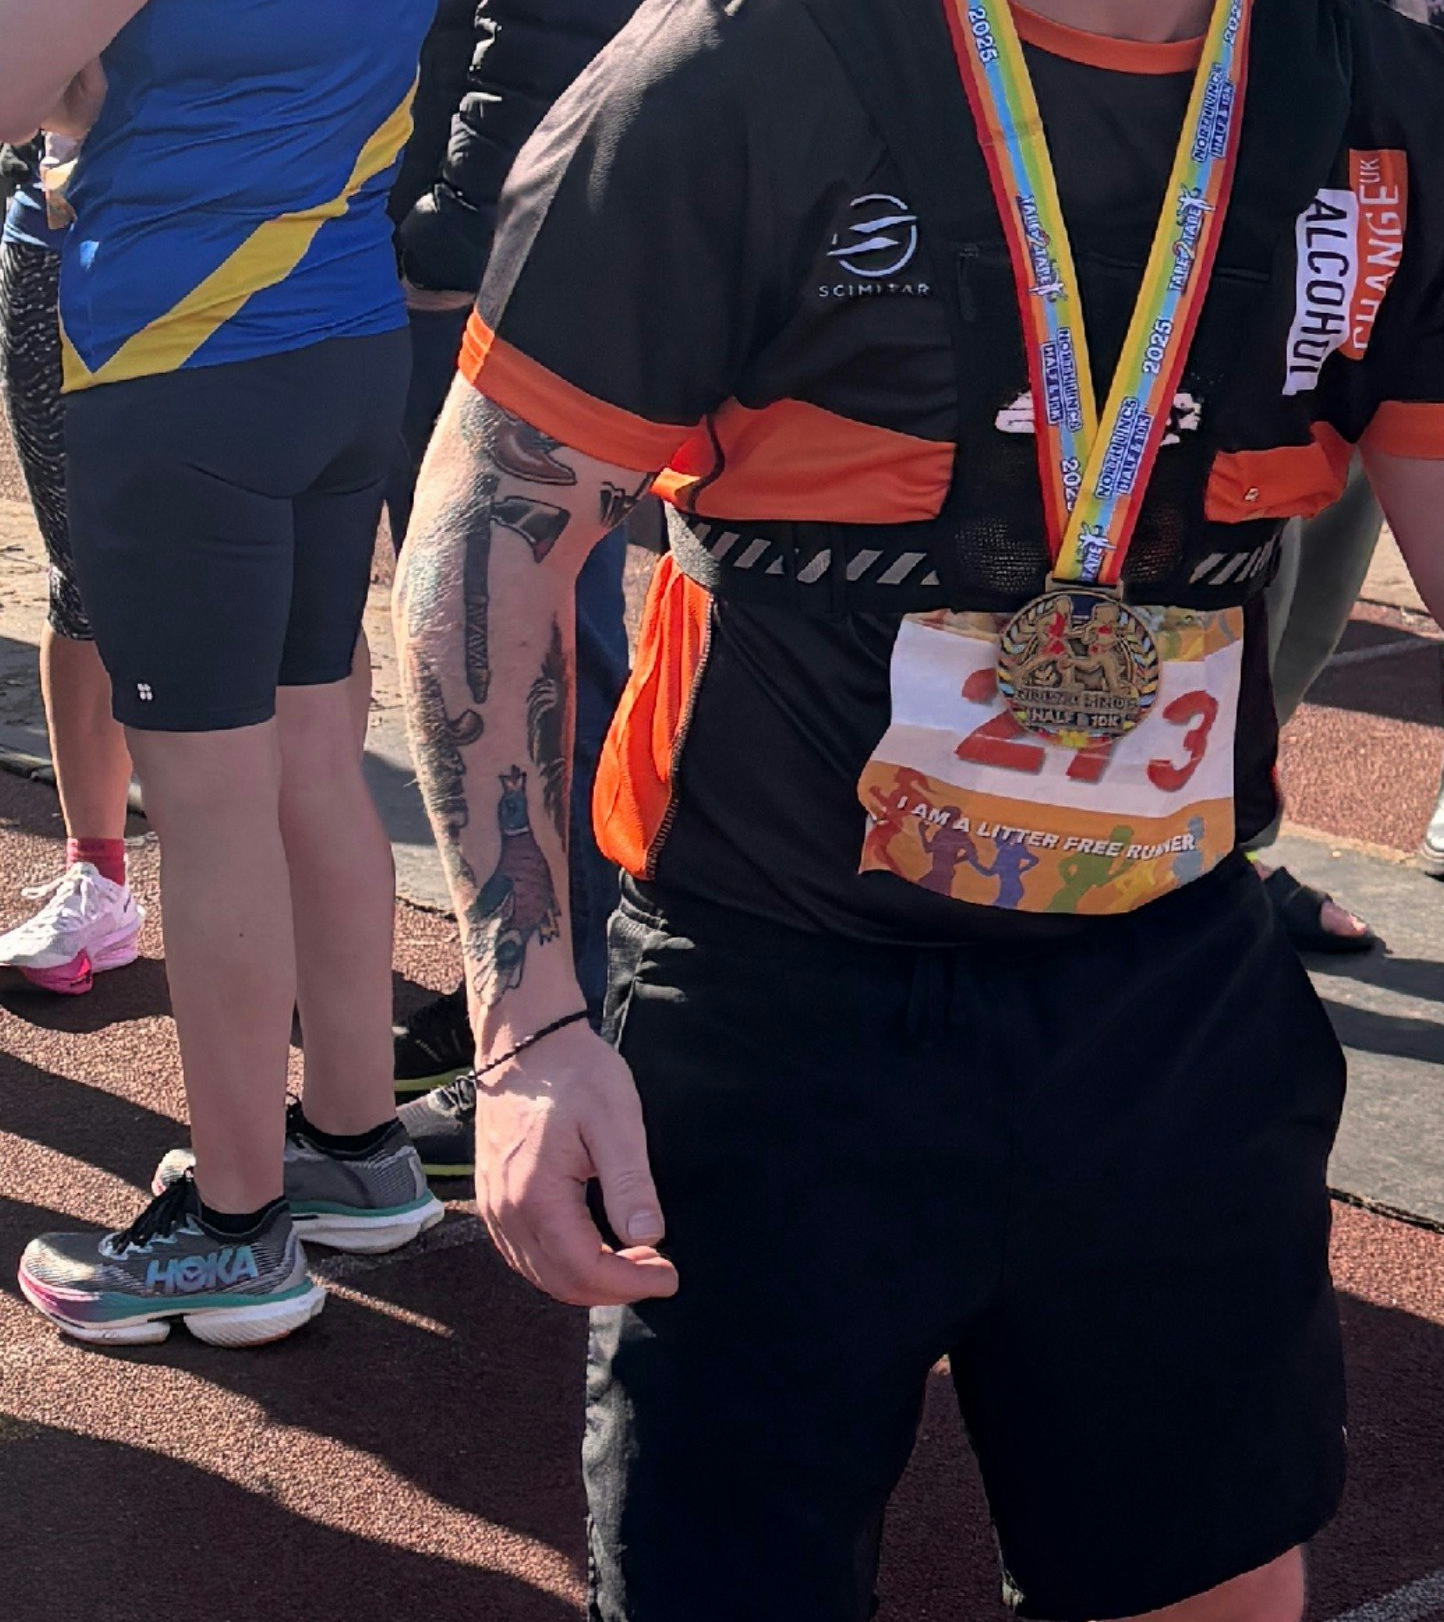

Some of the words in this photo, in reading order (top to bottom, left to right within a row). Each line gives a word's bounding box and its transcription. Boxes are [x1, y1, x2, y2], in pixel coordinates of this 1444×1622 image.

[968, 6, 999, 63] 2025
[1360, 157, 1380, 183] UK
[819, 282, 930, 298] SCIMITAR
[1289, 197, 1350, 373] ALCOHOL
[1353, 184, 1402, 349] CHANGE
[1142, 319, 1173, 374] 2025
[1061, 458, 1082, 511] 202
[897, 796, 908, 810] I
[911, 803, 951, 827] AM
[953, 816, 971, 832] A
[977, 820, 1059, 849] LITTER
[1063, 836, 1120, 858] FREE
[145, 1245, 258, 1294] HOKA
